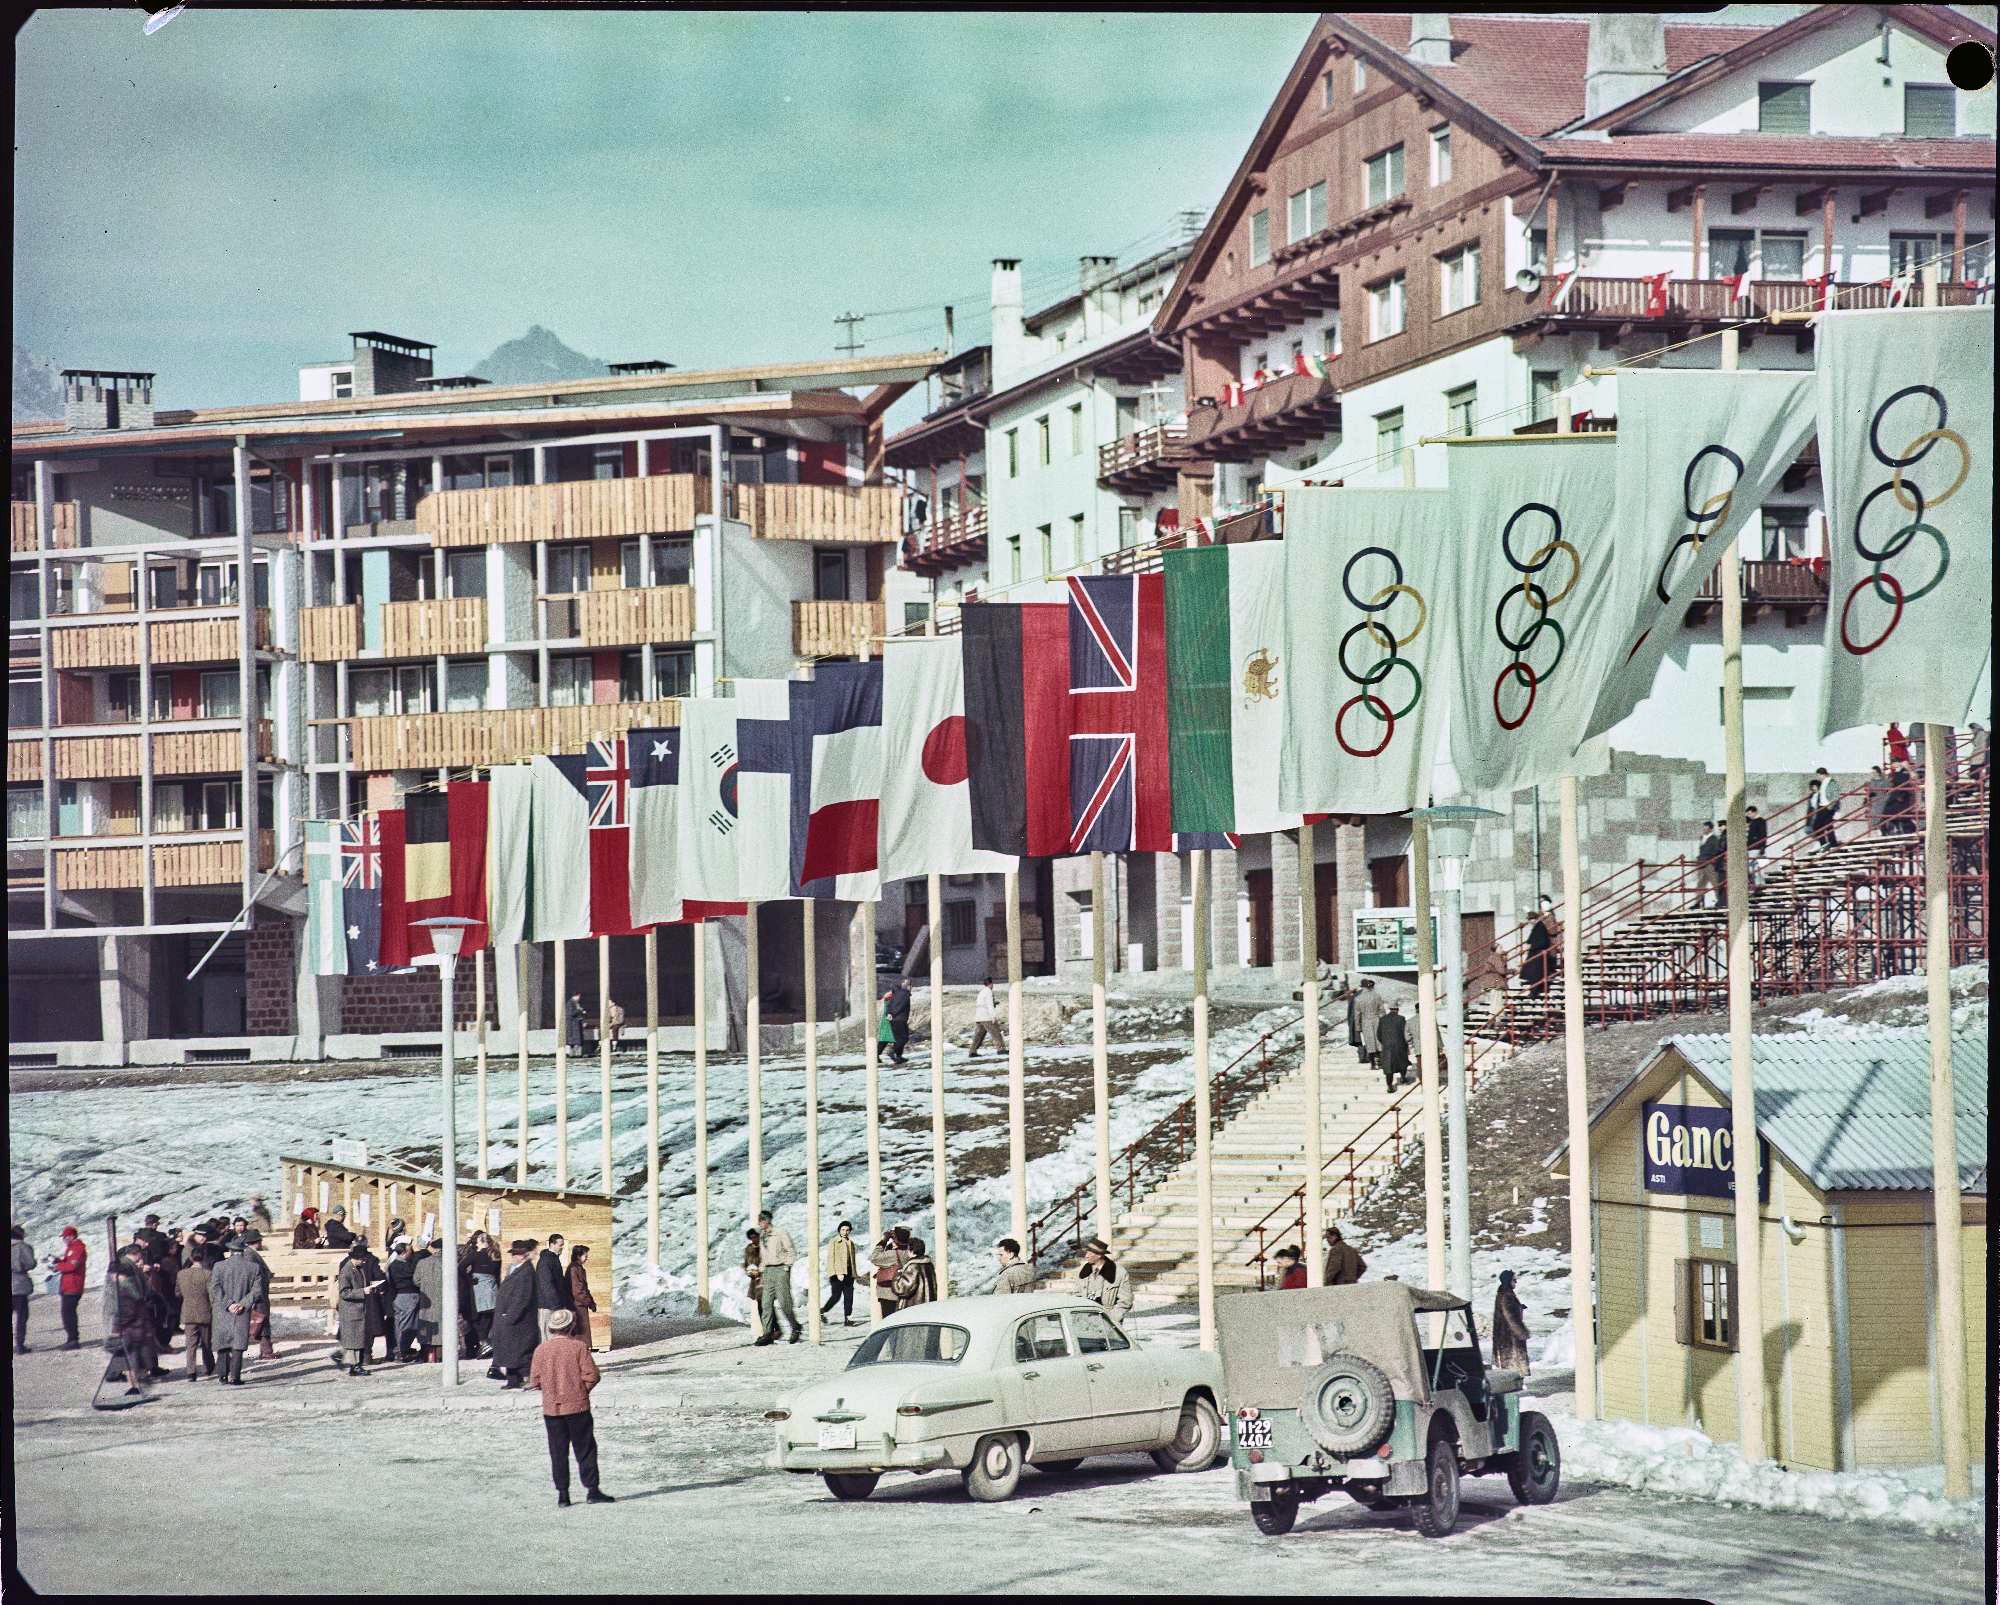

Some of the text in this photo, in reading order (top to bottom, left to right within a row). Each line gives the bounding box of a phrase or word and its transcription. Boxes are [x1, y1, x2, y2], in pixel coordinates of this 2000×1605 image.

[1646, 1110, 1763, 1175] Ganc
[1650, 1174, 1666, 1183] ASTI
[1239, 1433, 1273, 1447] 4404
